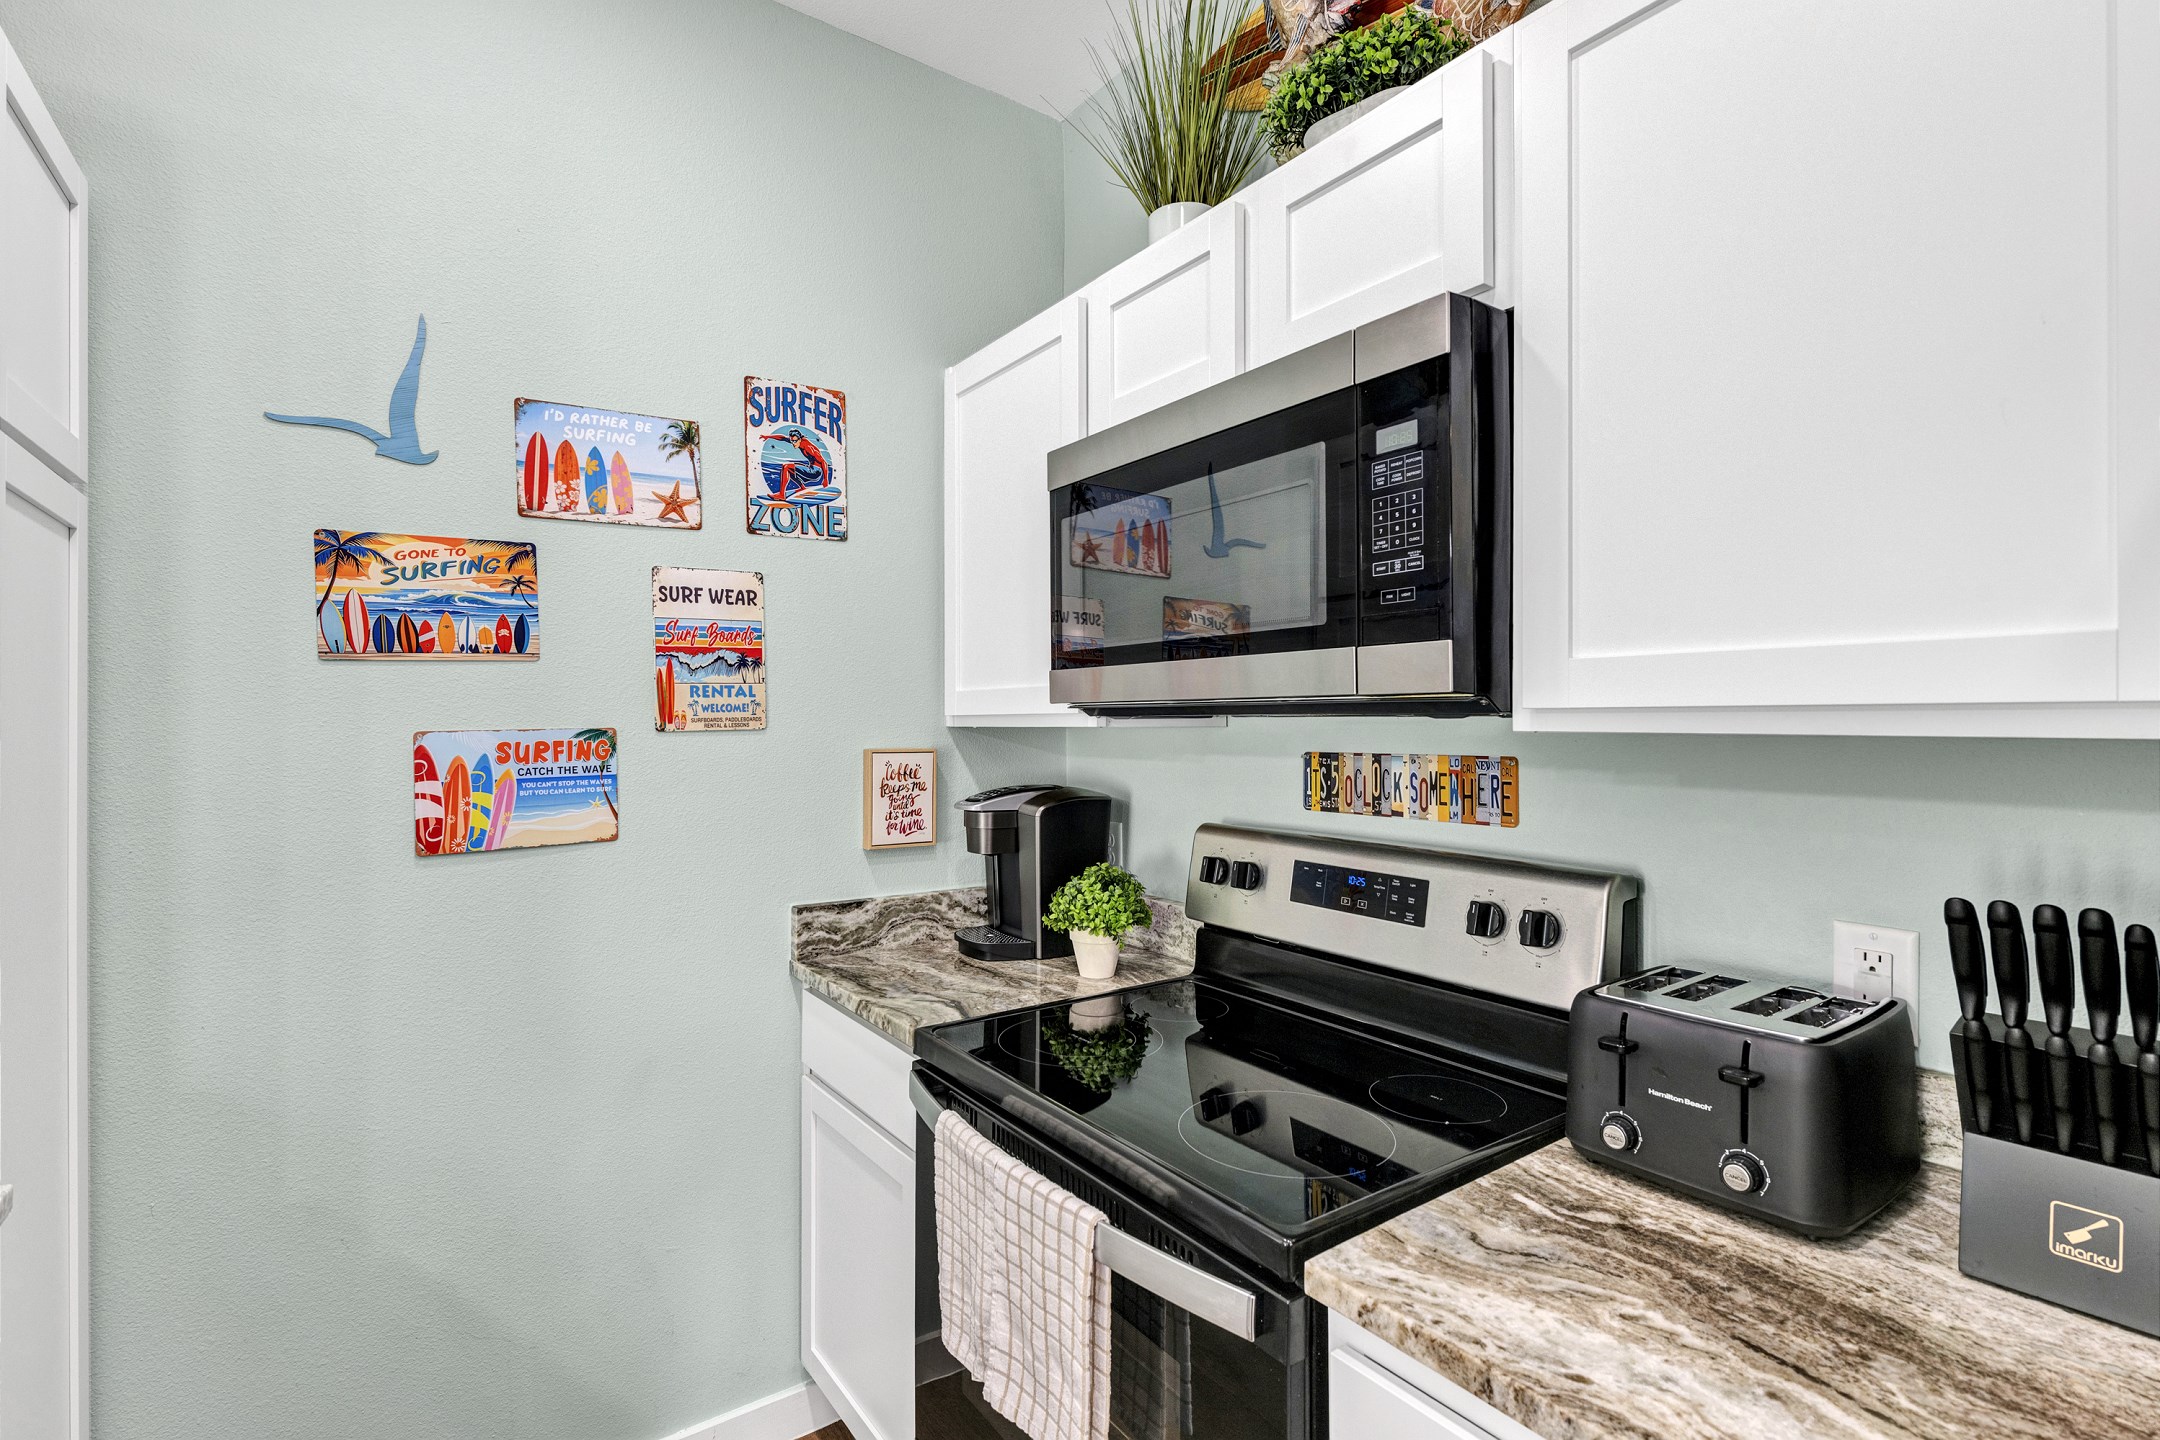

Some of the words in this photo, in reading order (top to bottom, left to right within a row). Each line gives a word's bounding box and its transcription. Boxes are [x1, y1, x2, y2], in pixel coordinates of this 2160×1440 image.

[544, 408, 565, 422] I'D
[570, 412, 629, 430] RATHER
[634, 420, 652, 433] BE
[750, 386, 842, 446] SURFER
[563, 425, 636, 446] SURFING
[750, 498, 844, 538] ZONE
[394, 549, 439, 561] GONE
[444, 547, 467, 558] TO
[380, 554, 501, 586] SURFING
[659, 585, 704, 604] SURF
[708, 588, 758, 606] WEAR
[663, 618, 700, 647] Surf
[706, 622, 757, 647] Boards
[690, 685, 756, 698] RENTAL
[701, 703, 749, 713] WELCOME!
[494, 739, 612, 765] SURFING
[517, 767, 554, 776] CATCH
[557, 766, 578, 774] THE
[582, 764, 612, 774] WAVE
[1348, 875, 1366, 887] 10:25
[1648, 1088, 1684, 1104] Hamilton
[1684, 1098, 1710, 1112] Beach
[1725, 1172, 1747, 1184] CANCEL
[2056, 1242, 2117, 1269] imarku
